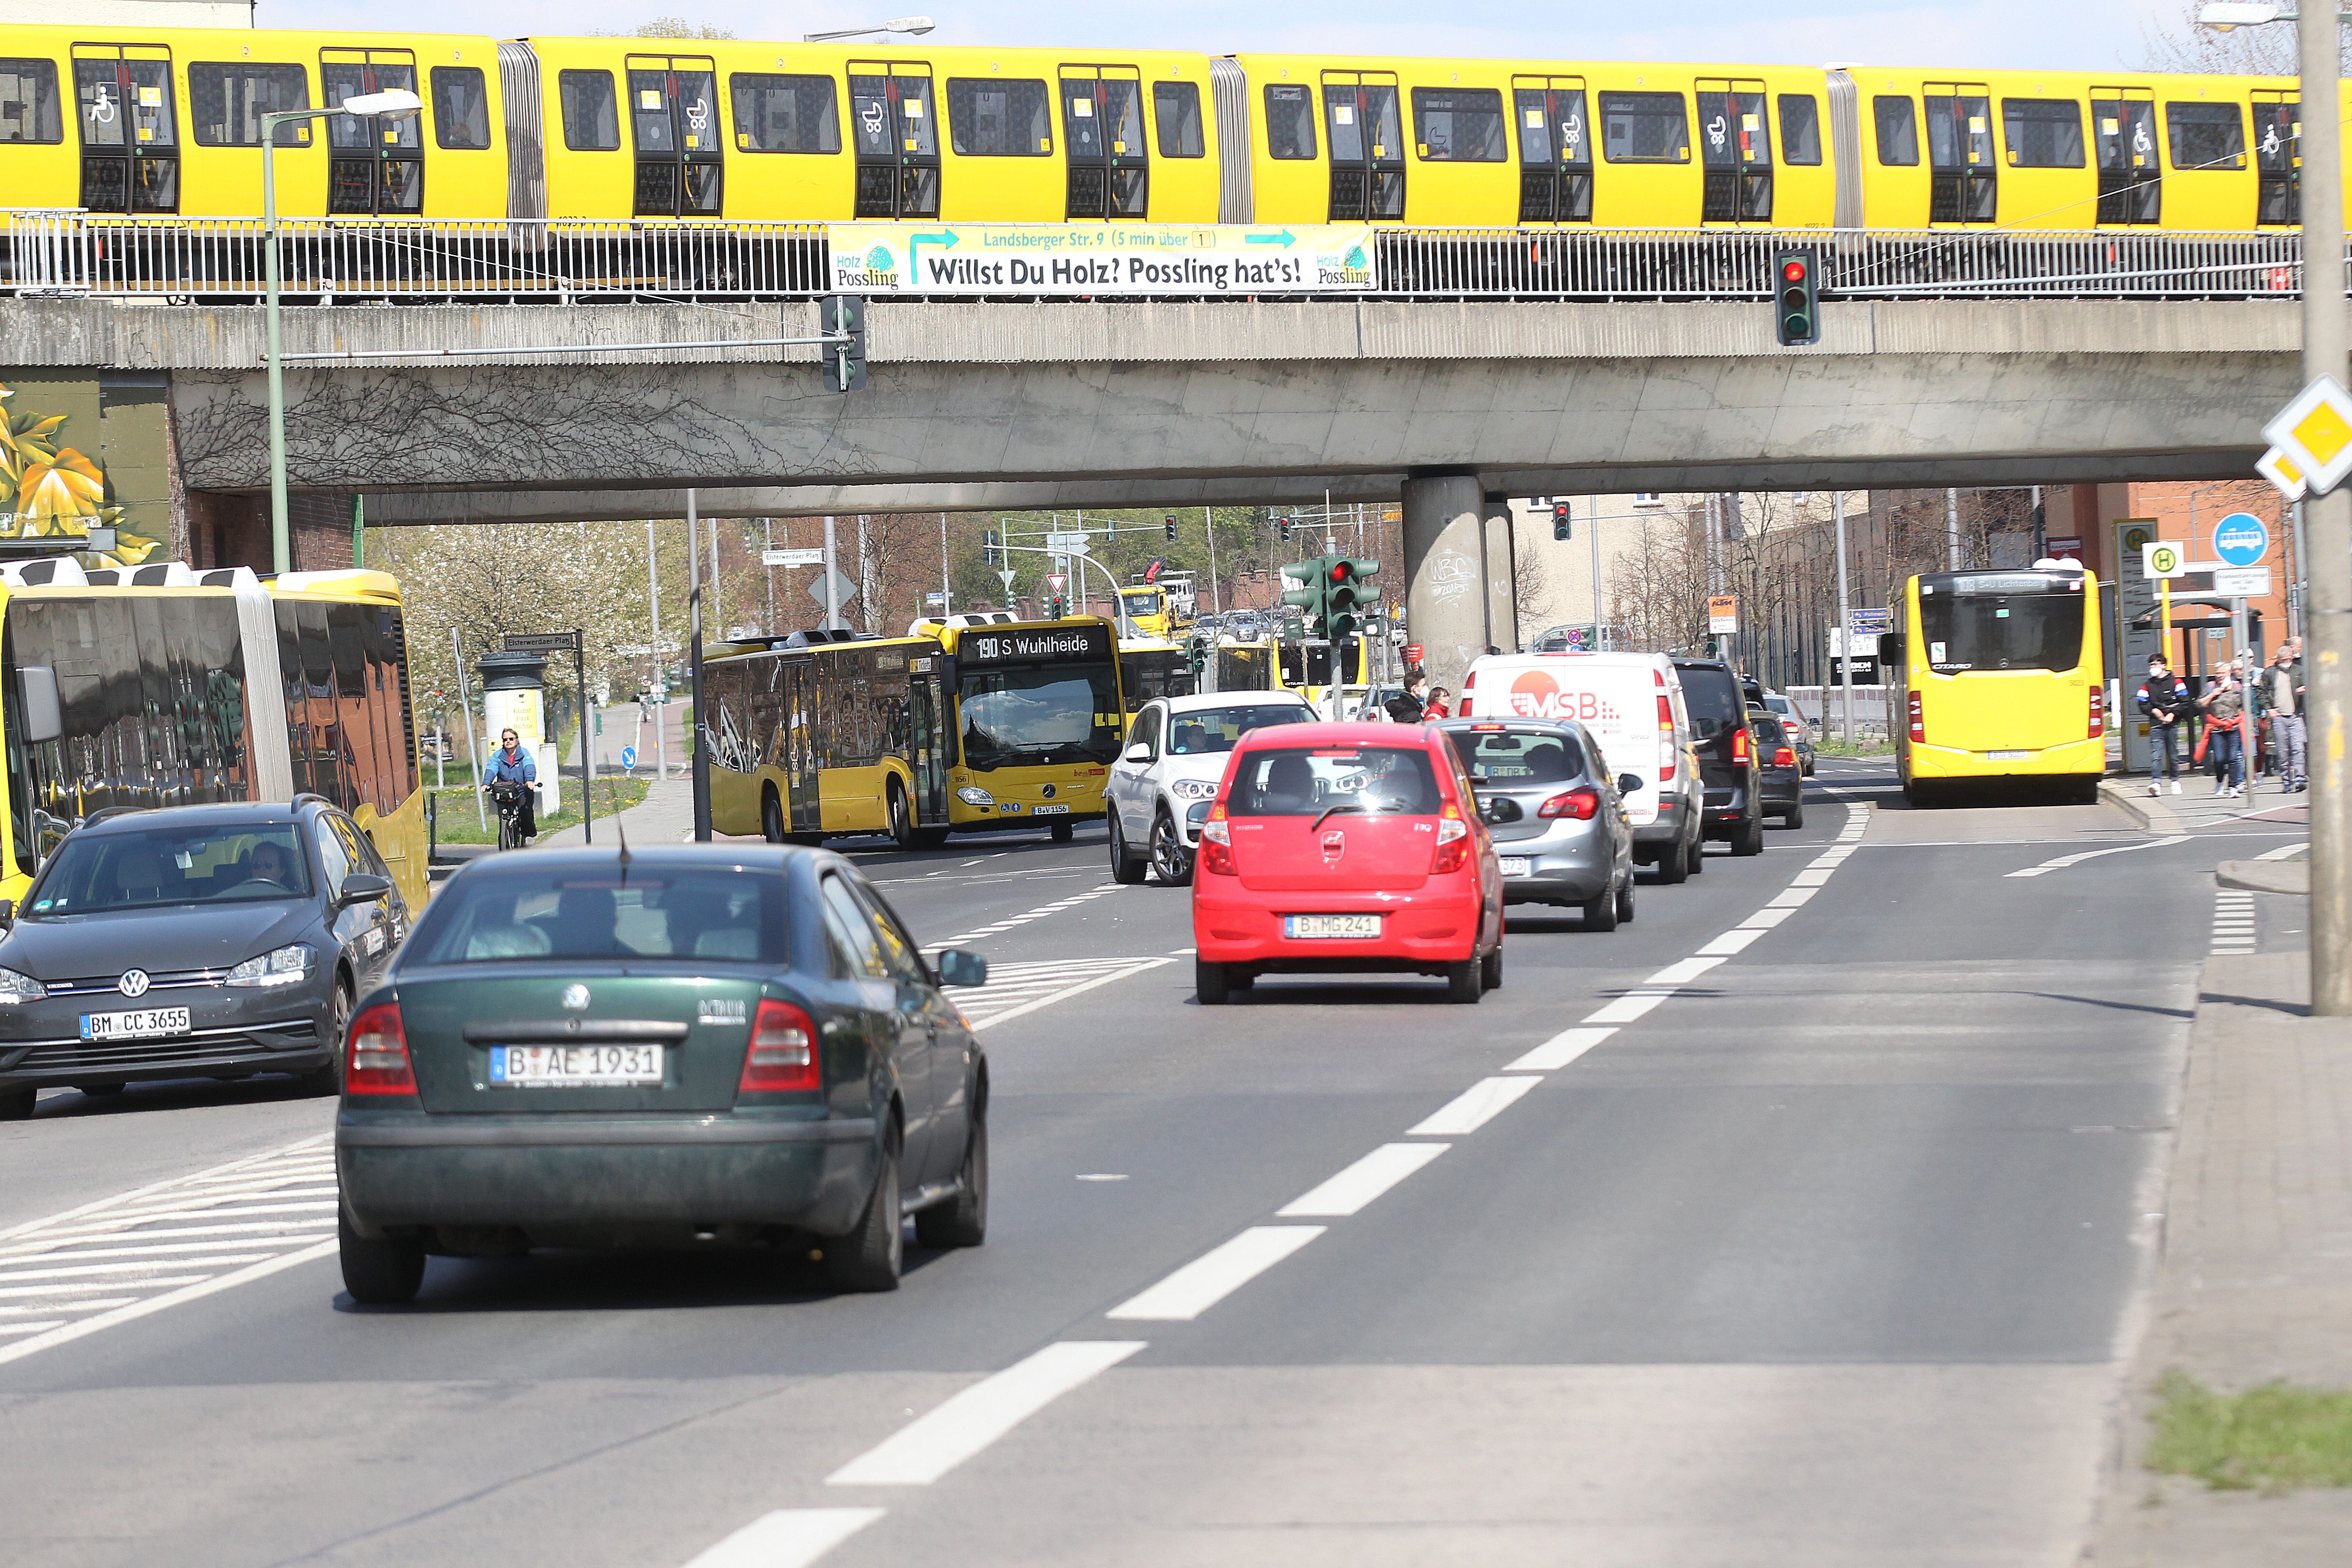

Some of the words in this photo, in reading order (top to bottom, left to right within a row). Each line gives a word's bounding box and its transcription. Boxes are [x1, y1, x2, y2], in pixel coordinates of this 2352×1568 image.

[984, 232, 1065, 251] Landsberger
[1069, 232, 1093, 246] Str.
[1097, 232, 1104, 245] 9
[1112, 229, 1125, 248] (5
[1129, 232, 1155, 245] min
[1159, 232, 1188, 246] über
[837, 256, 860, 268] Holz
[1317, 255, 1339, 267] Holz
[838, 270, 899, 290] Possling
[929, 258, 1003, 284] Willst
[1011, 259, 1043, 284] Du
[1053, 258, 1120, 284] Holz?
[1129, 258, 1228, 289] Possling
[1235, 257, 1301, 283] hat's!
[1318, 269, 1371, 288] Possling
[2158, 553, 2171, 567] H
[555, 637, 570, 645] Platz
[977, 638, 998, 659] 190
[1002, 639, 1012, 655] S
[1016, 635, 1089, 654] Wuhlheide
[1836, 635, 1871, 644] KCH
[1837, 644, 1871, 653] SORE
[1526, 692, 1599, 720] MSB
[1301, 918, 1310, 932] B
[1322, 917, 1341, 932] MG
[1346, 917, 1373, 932] 241
[698, 999, 746, 1016] OCTAVIA
[92, 1016, 111, 1033] BM
[124, 1014, 143, 1031] CC
[148, 1010, 187, 1029] 3655
[510, 1048, 525, 1075] B
[548, 1048, 579, 1074] AE
[590, 1048, 657, 1074] 1931
